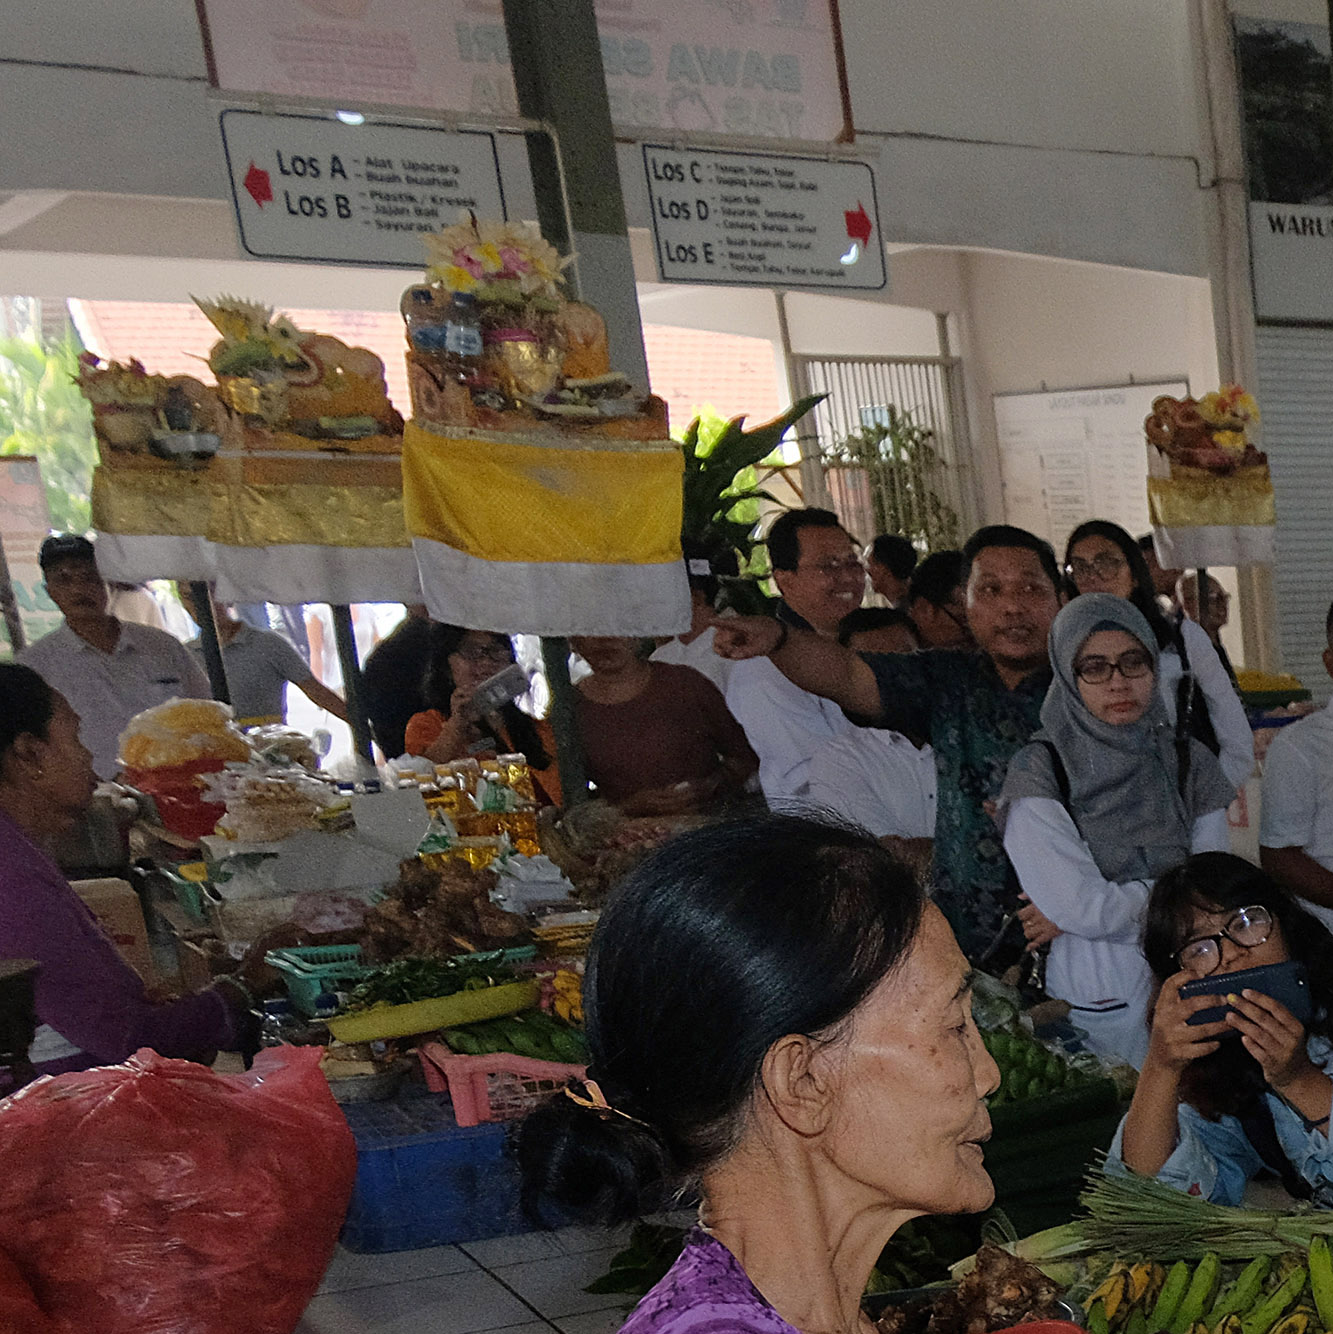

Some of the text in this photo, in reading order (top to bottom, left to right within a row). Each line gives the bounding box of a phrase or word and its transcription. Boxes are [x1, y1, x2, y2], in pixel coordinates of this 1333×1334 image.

[276, 150, 347, 179] LOS A
[652, 157, 703, 183] LOS C
[284, 190, 352, 219] LOS B
[657, 197, 710, 221] LOS D
[664, 239, 715, 264] LOS E
